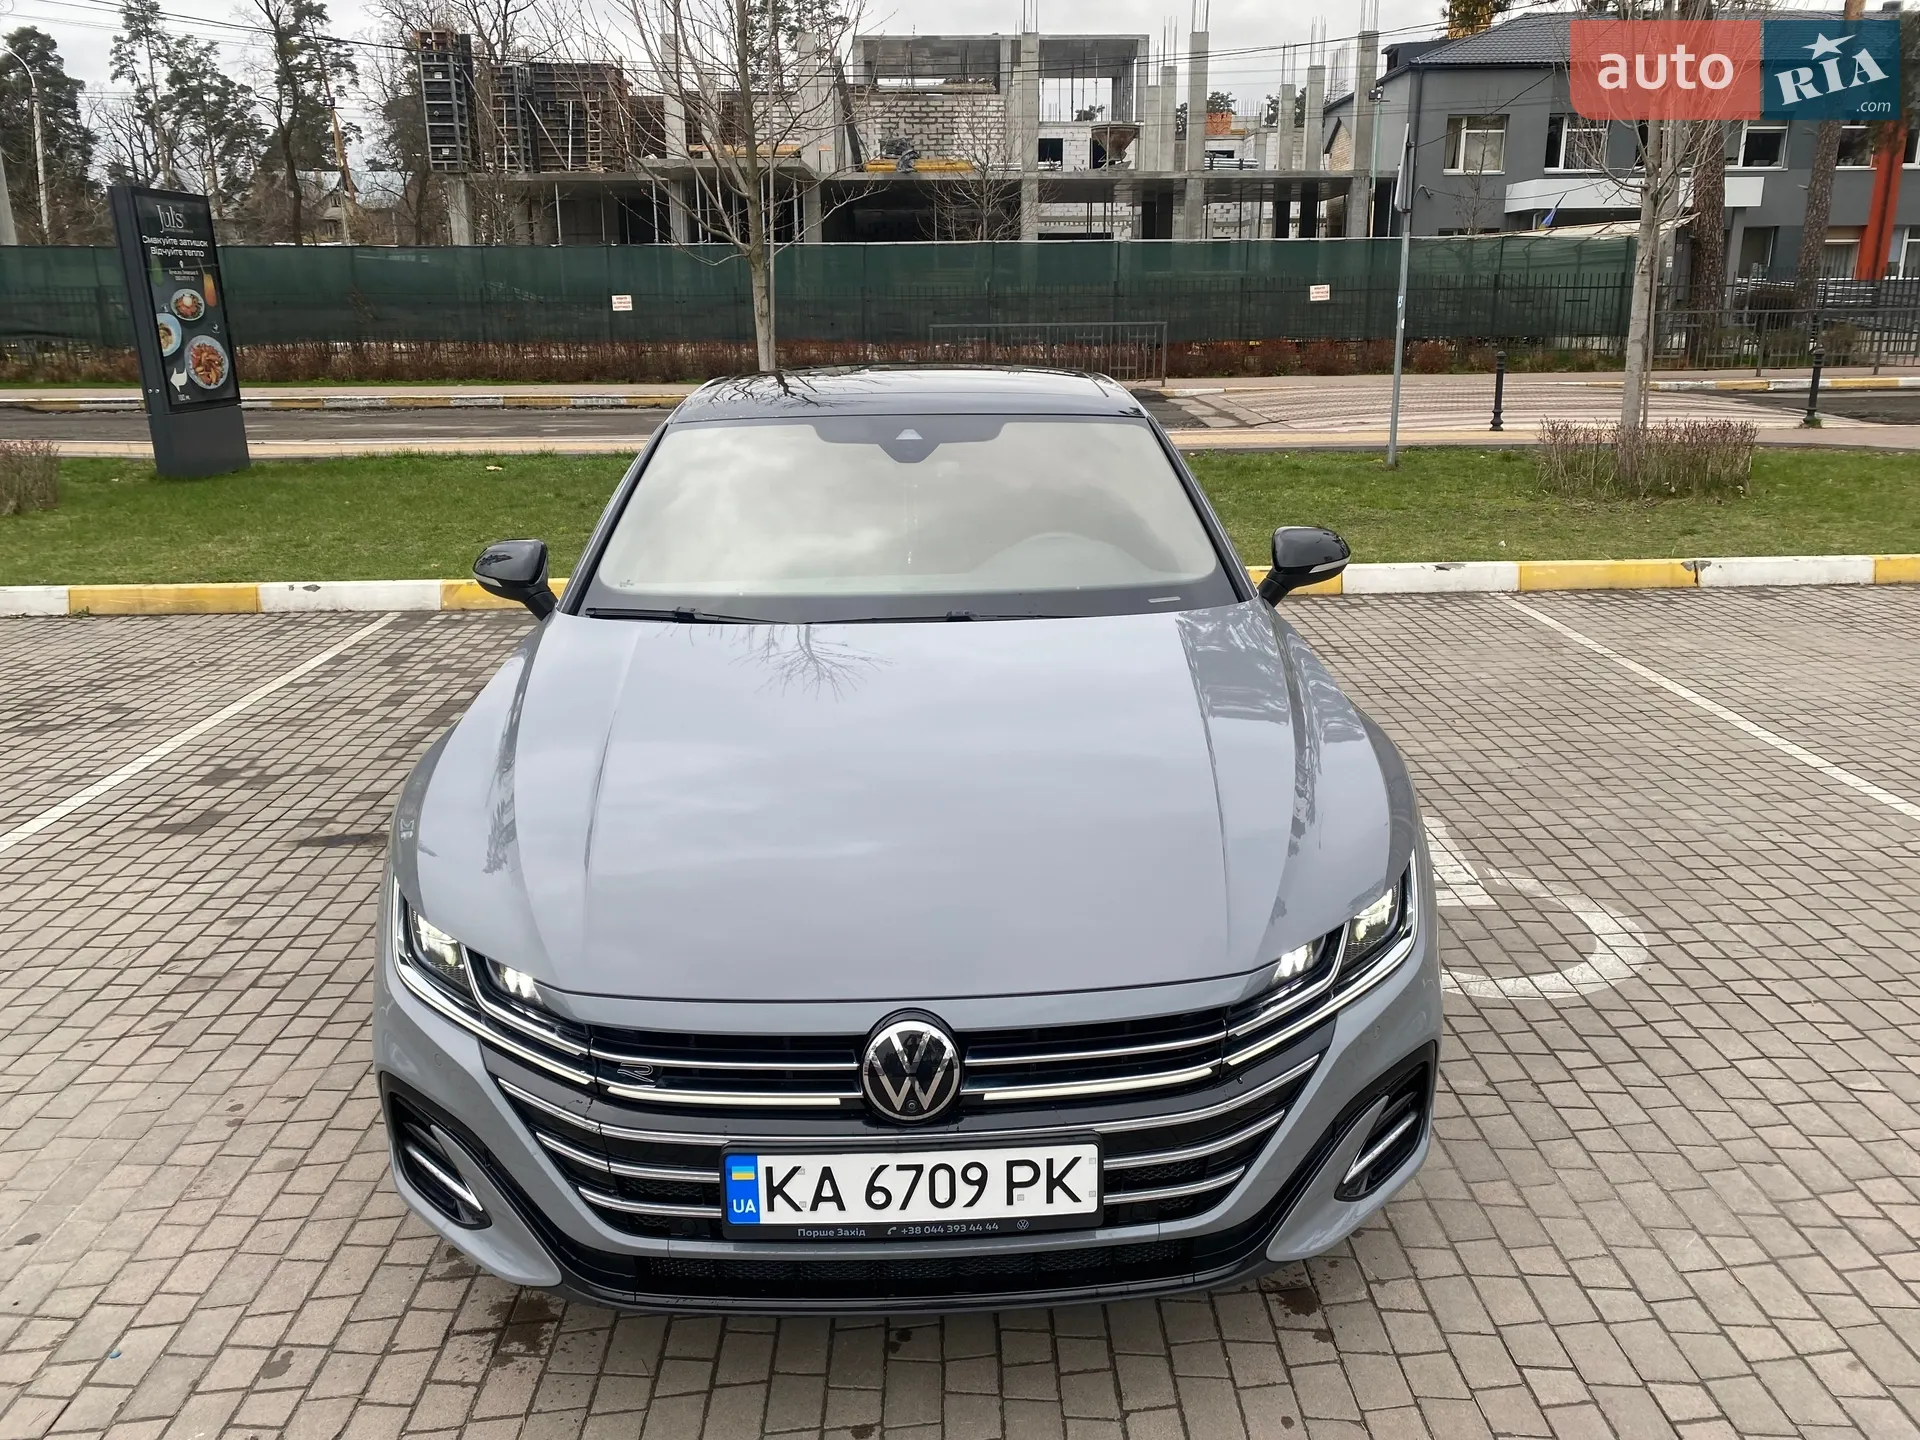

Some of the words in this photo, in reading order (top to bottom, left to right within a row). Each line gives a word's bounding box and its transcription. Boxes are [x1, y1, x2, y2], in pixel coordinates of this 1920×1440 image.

[142, 235, 178, 246] Смакуйте
[179, 239, 209, 247] затишок
[150, 246, 183, 257] Відчуйте
[183, 249, 205, 258] тепло
[765, 1166, 846, 1212] KA
[865, 1161, 988, 1211] 6709
[1006, 1156, 1082, 1206] PK
[733, 1199, 756, 1213] UA
[797, 1228, 835, 1238] Порше
[836, 1227, 866, 1237] Захід
[901, 1226, 921, 1235] +38
[924, 1225, 944, 1234] 044
[946, 1224, 967, 1233] 393
[969, 1223, 983, 1232] 44
[985, 1222, 999, 1231] 44
